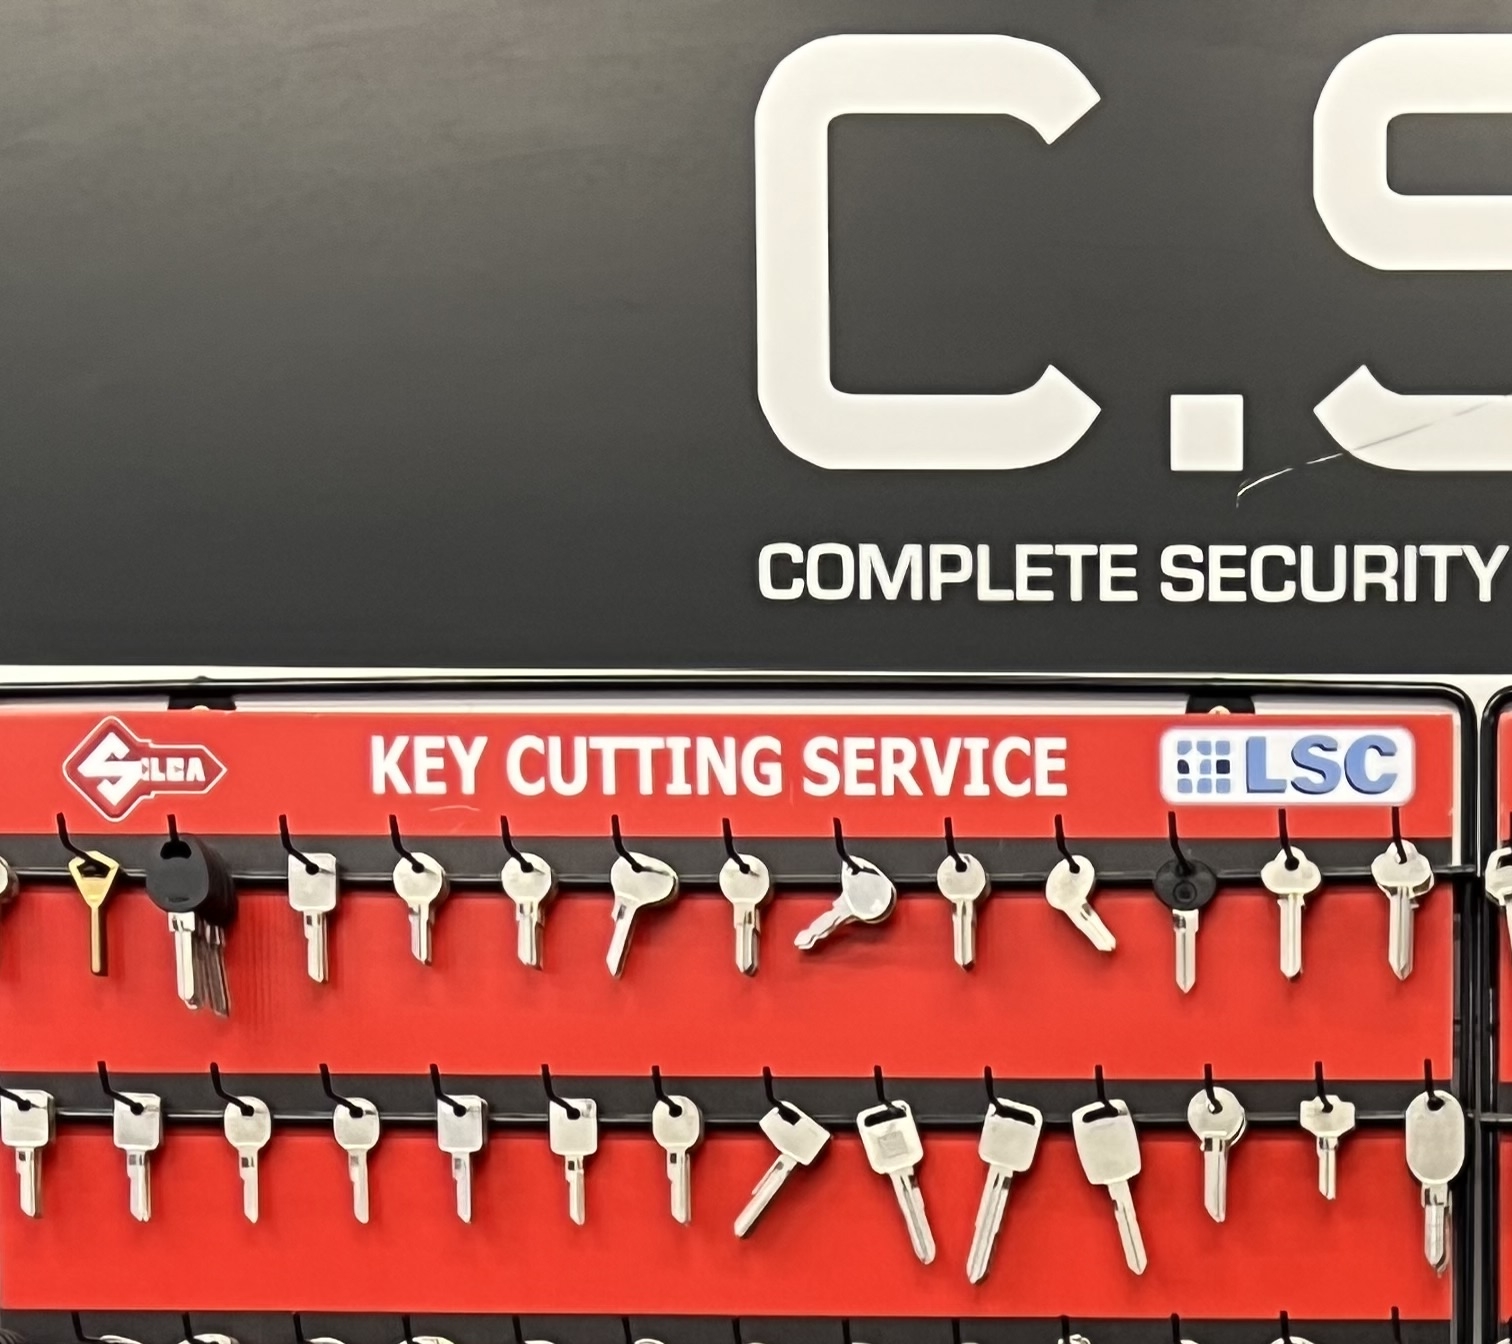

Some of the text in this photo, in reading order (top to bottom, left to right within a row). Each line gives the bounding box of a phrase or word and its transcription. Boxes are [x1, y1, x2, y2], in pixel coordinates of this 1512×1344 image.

[758, 542, 1139, 602] COMPLETE
[1160, 543, 1510, 603] SECURITY
[370, 734, 1068, 798] KEY CUTTING SERVICE
[1245, 734, 1398, 795] LSC
